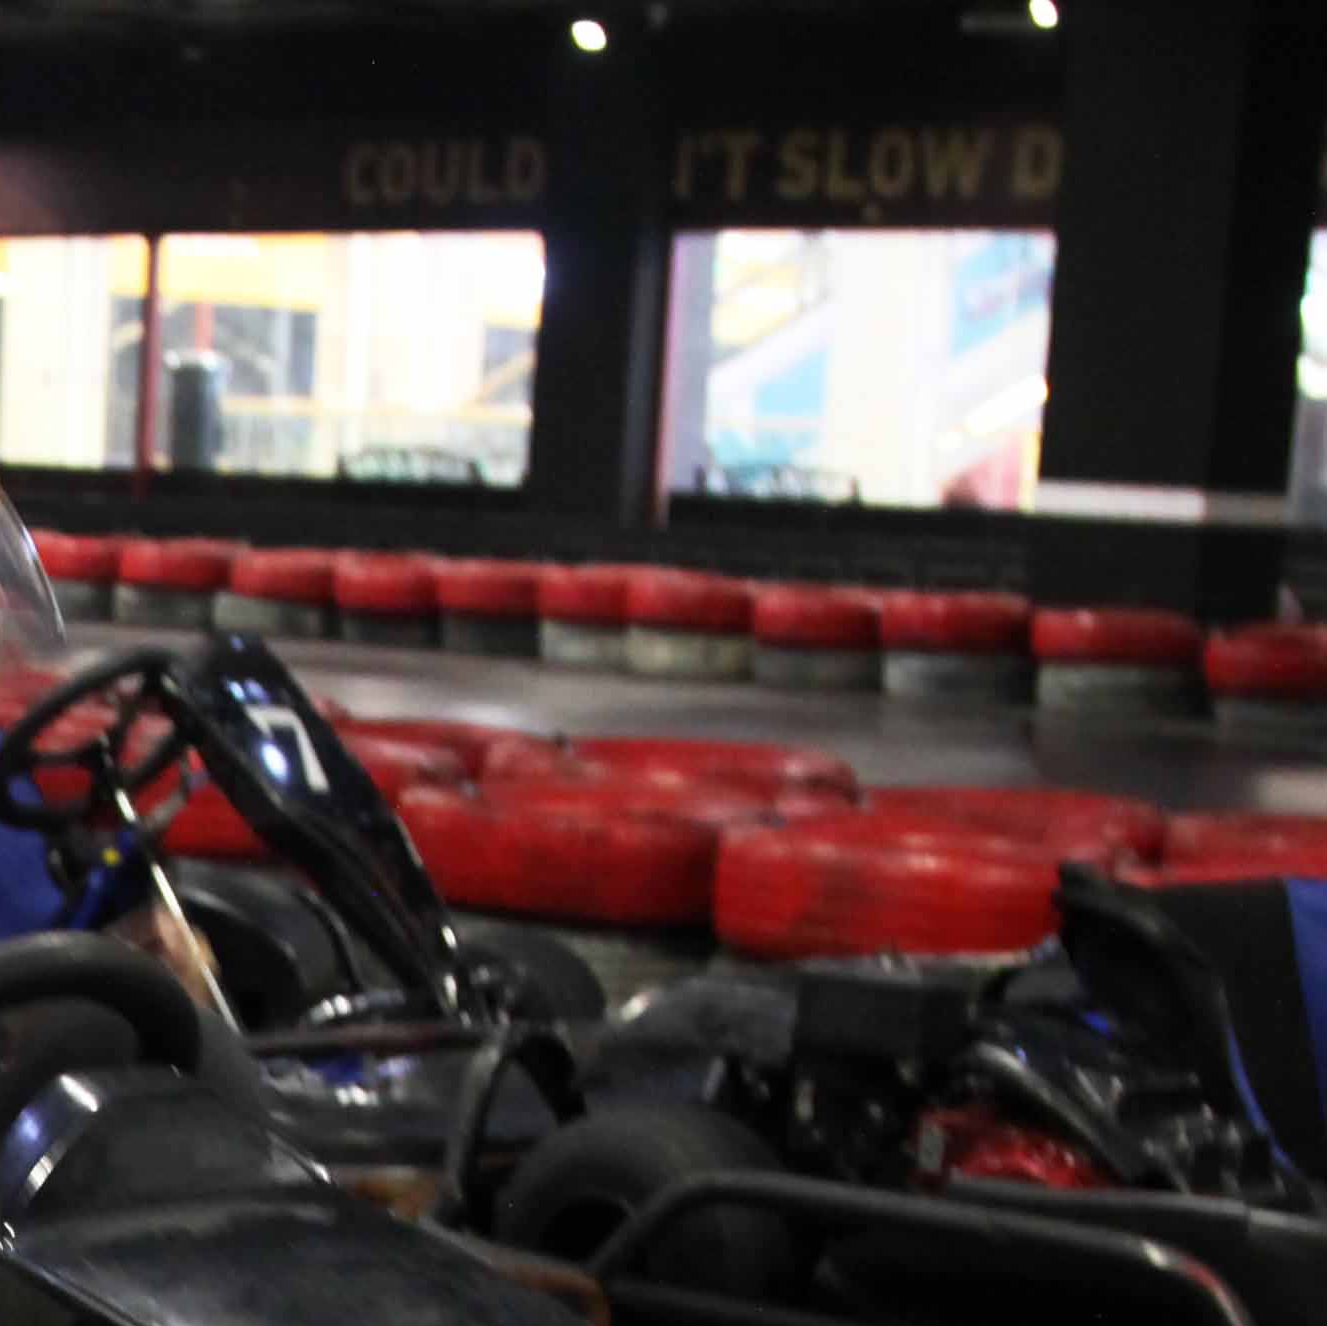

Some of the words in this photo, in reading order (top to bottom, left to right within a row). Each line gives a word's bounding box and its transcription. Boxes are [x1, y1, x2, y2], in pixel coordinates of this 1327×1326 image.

[343, 140, 547, 206] COULD
[777, 126, 996, 201] SLOW
[245, 706, 330, 791] 7
